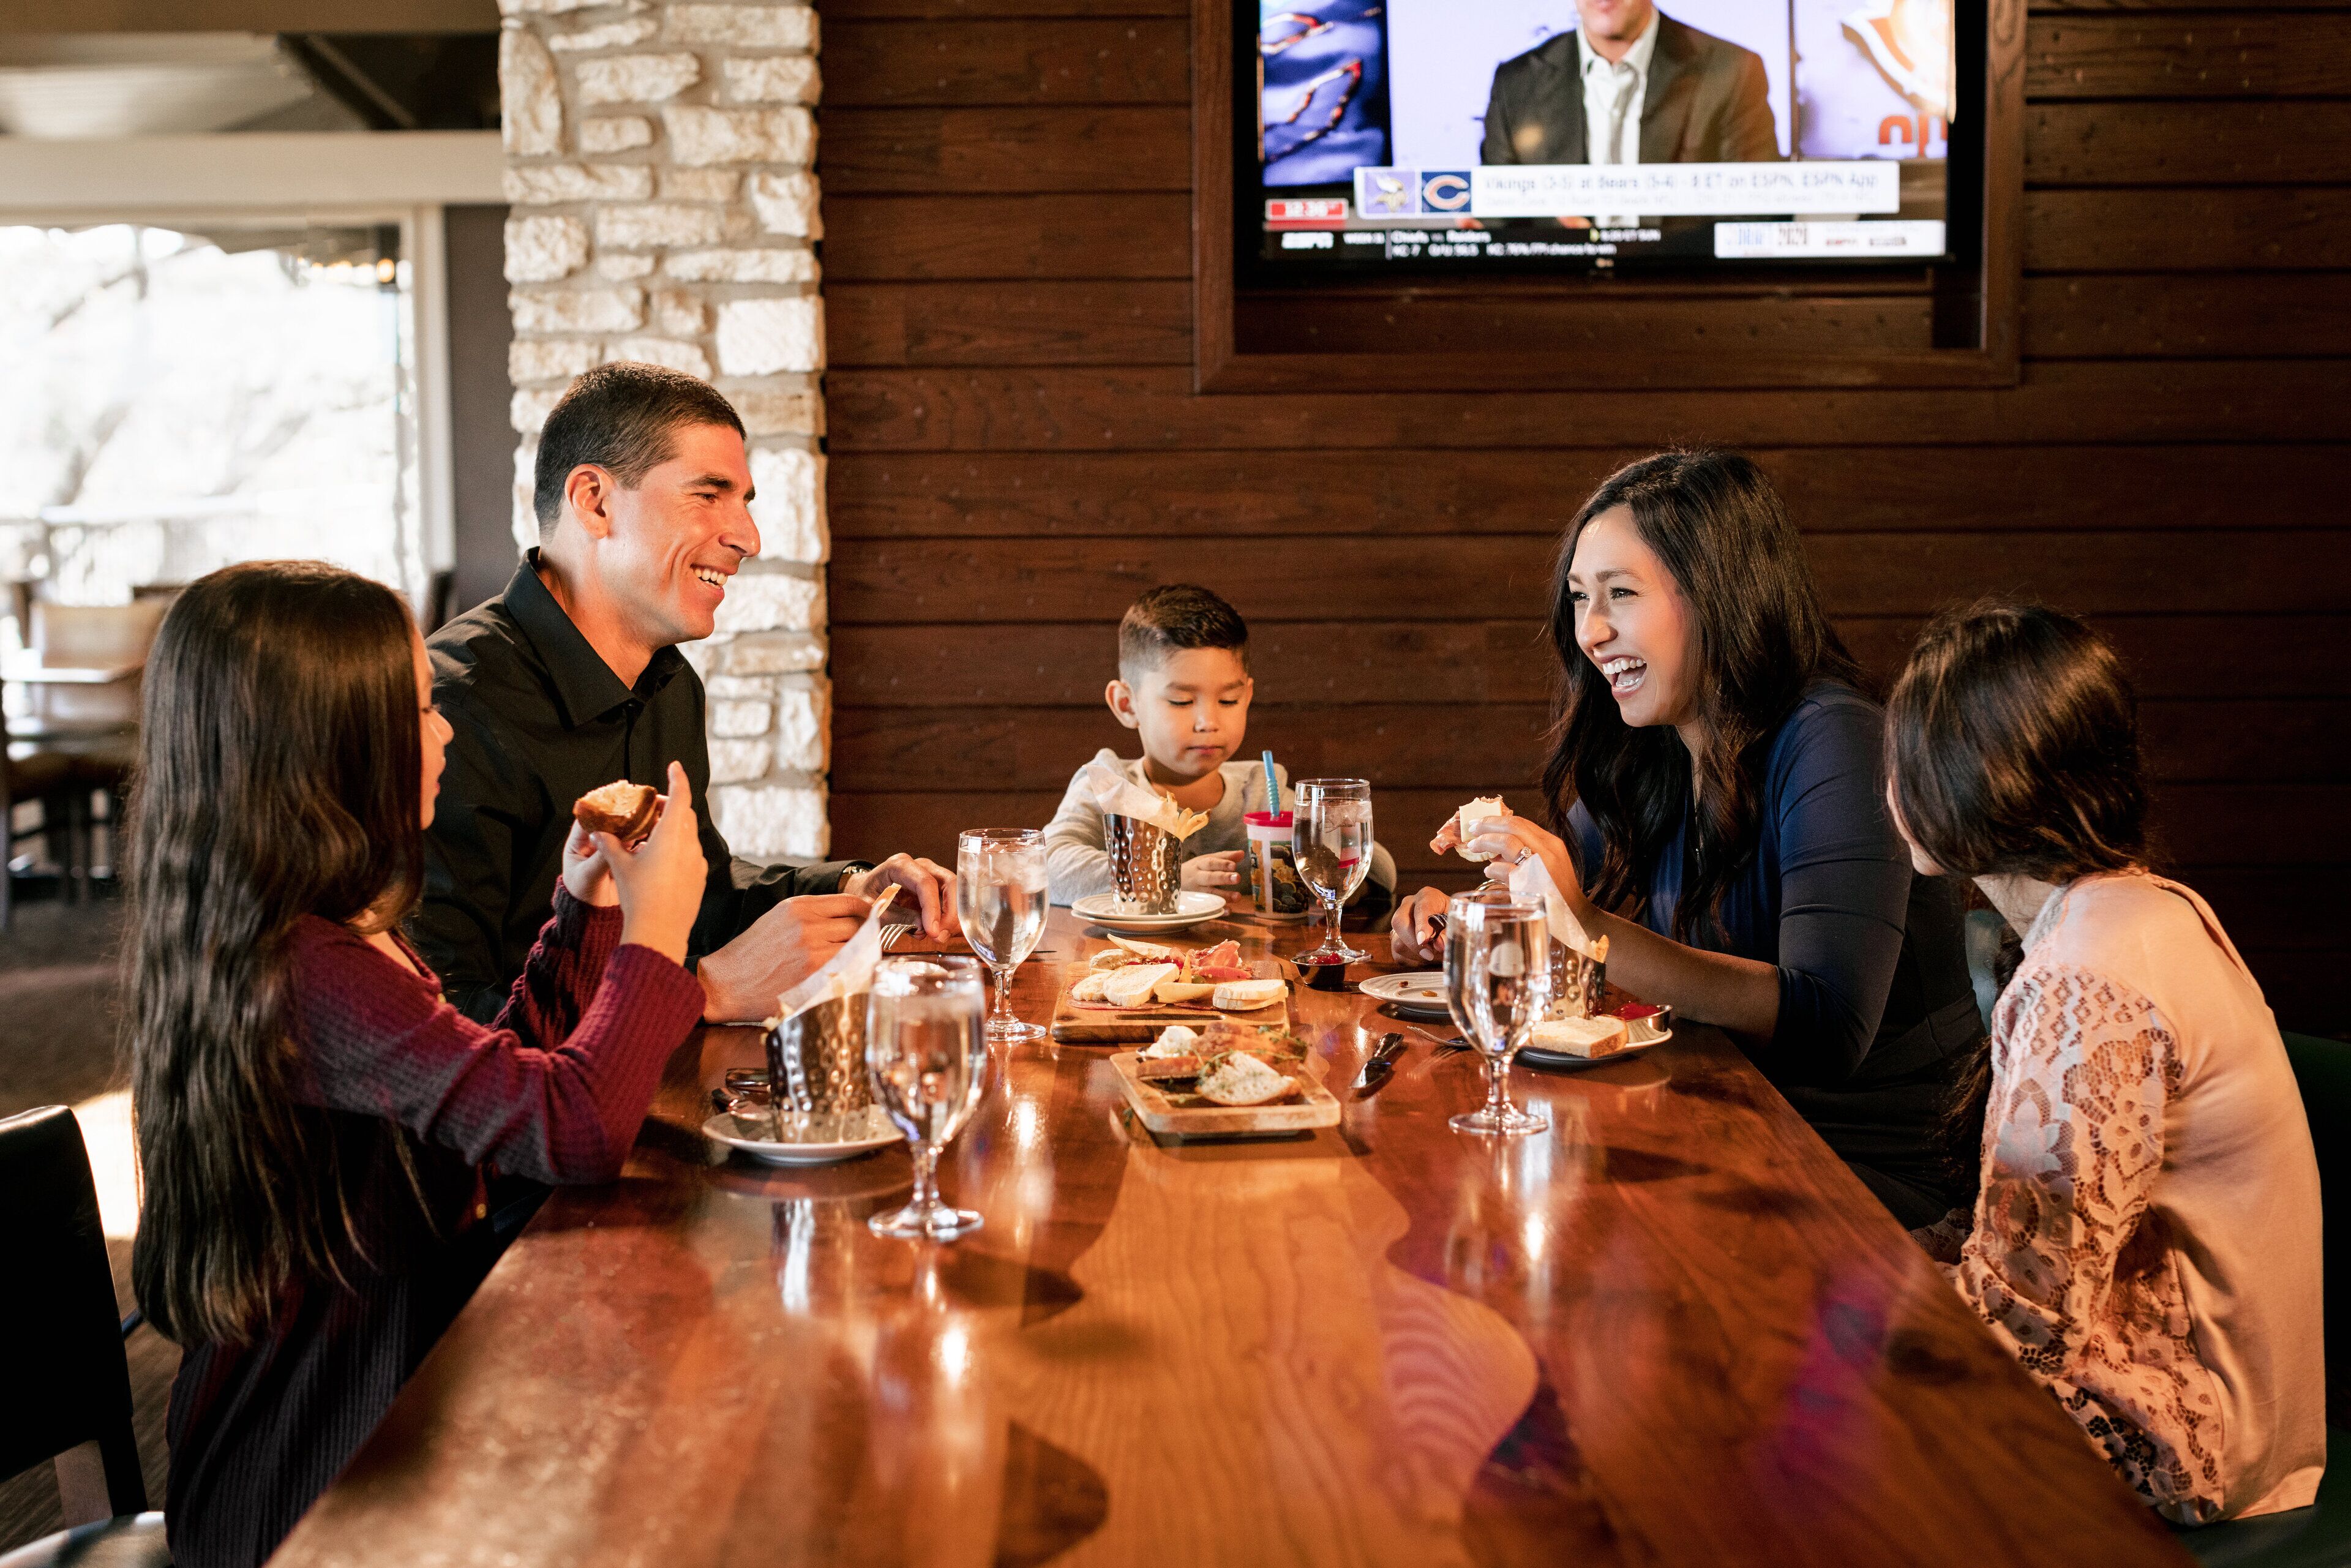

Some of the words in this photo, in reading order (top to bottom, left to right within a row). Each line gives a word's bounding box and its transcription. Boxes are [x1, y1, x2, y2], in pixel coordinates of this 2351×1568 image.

[1485, 174, 1536, 194] Vikings
[1597, 174, 1640, 190] Bears
[1801, 173, 1843, 190] ESPN
[1447, 230, 1491, 243] Raiders
